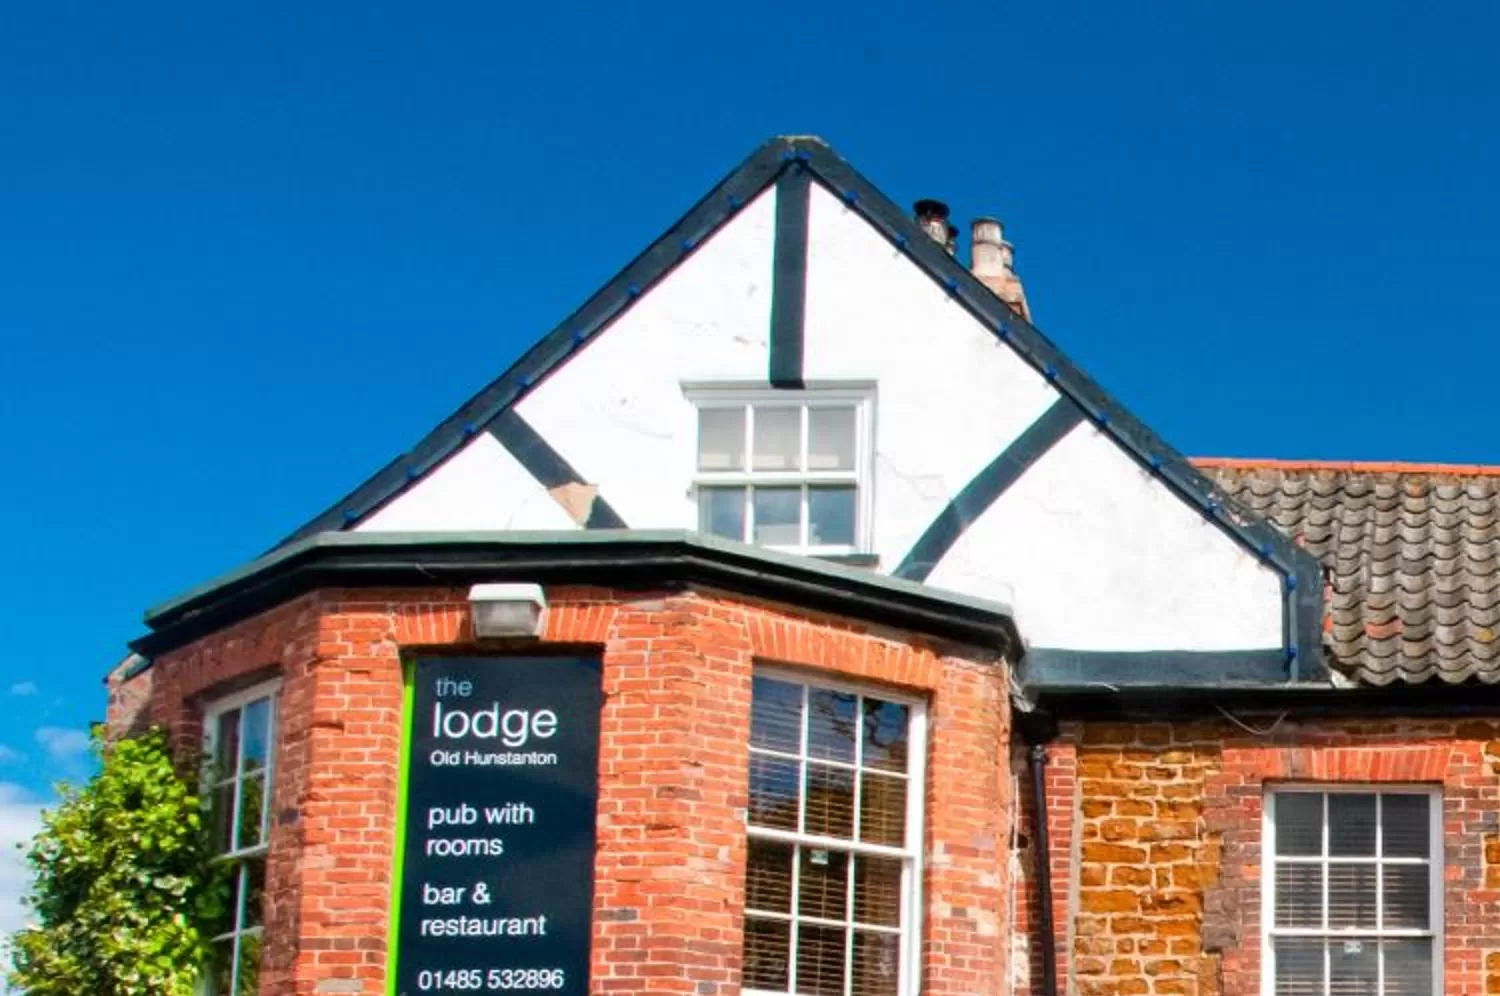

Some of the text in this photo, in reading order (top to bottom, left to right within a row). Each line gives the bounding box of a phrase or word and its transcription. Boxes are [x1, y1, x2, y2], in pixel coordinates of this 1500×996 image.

[435, 678, 473, 697] the
[433, 701, 558, 747] lodge
[430, 750, 558, 766] Old Hunstanton
[428, 802, 534, 830] pub with
[426, 838, 503, 857] rooms
[423, 881, 491, 905] bar &
[421, 914, 546, 937] restaurant
[418, 968, 564, 990] 01485 532896
